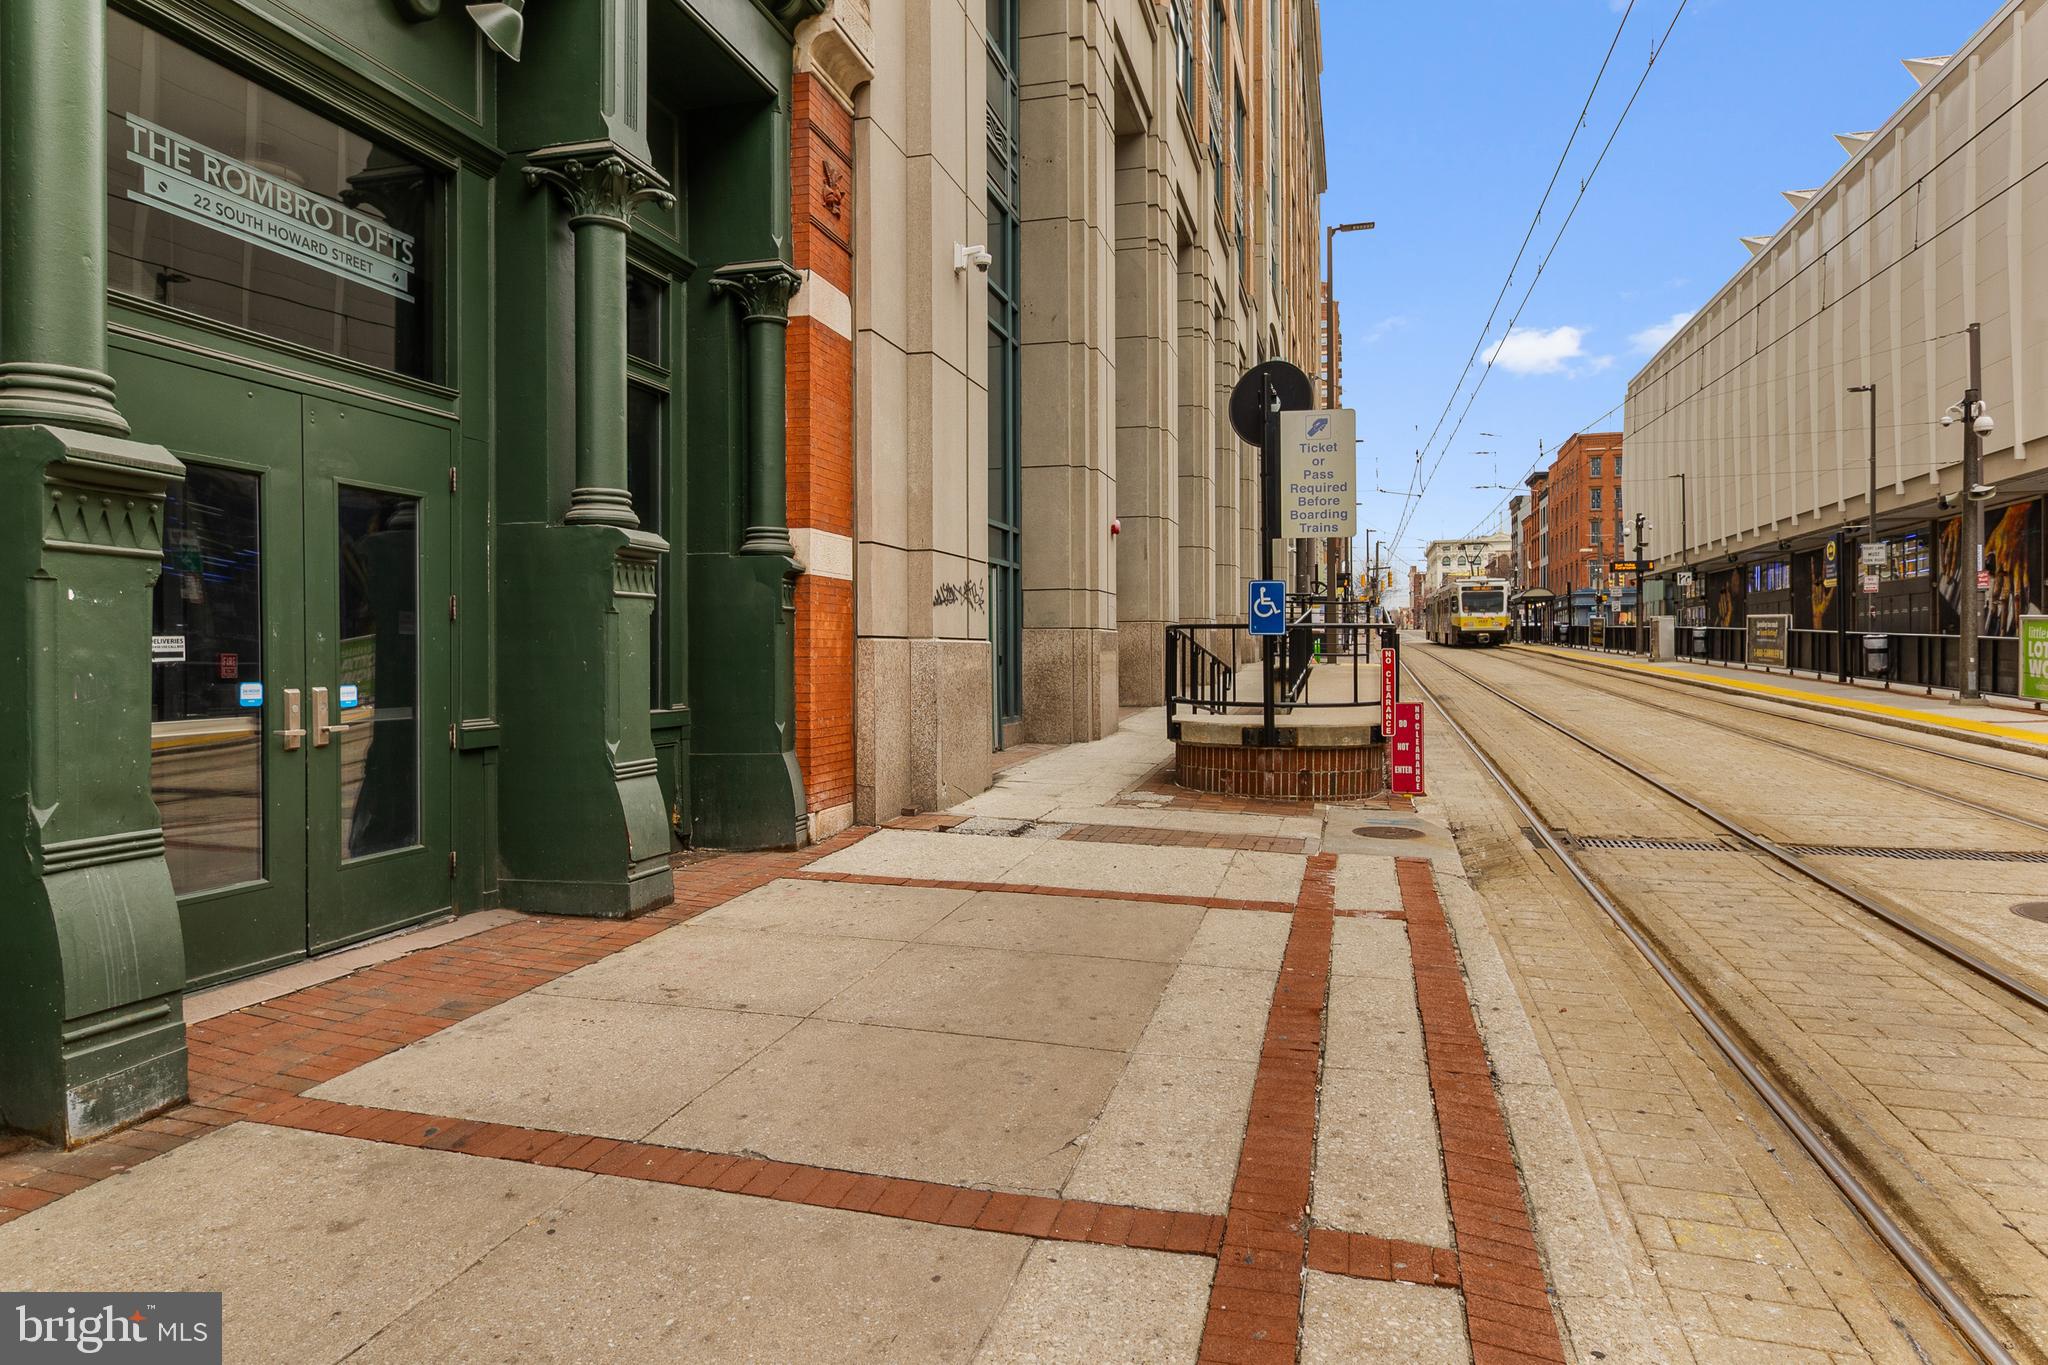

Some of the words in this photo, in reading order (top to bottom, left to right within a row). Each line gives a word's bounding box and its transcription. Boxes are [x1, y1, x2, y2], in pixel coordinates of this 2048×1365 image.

[131, 123, 191, 175] THE
[203, 154, 333, 231] ROMBRO
[342, 214, 414, 265] LOFTS
[193, 193, 211, 213] 22
[216, 202, 263, 233] SOUTH
[268, 223, 328, 256] HOWARD
[332, 247, 374, 275] STREET
[1299, 442, 1338, 453] Ticket
[1312, 457, 1325, 466] or
[1303, 469, 1334, 480] Pass
[1290, 481, 1348, 495] Required
[1298, 496, 1340, 507] Before
[1290, 509, 1348, 521] Boarding
[1299, 522, 1339, 533] Trains
[1385, 651, 1392, 664] NO
[1414, 706, 1420, 720] NO
[1398, 719, 1408, 728] DO
[1397, 742, 1410, 751] NOT
[1394, 765, 1413, 774] ENTER
